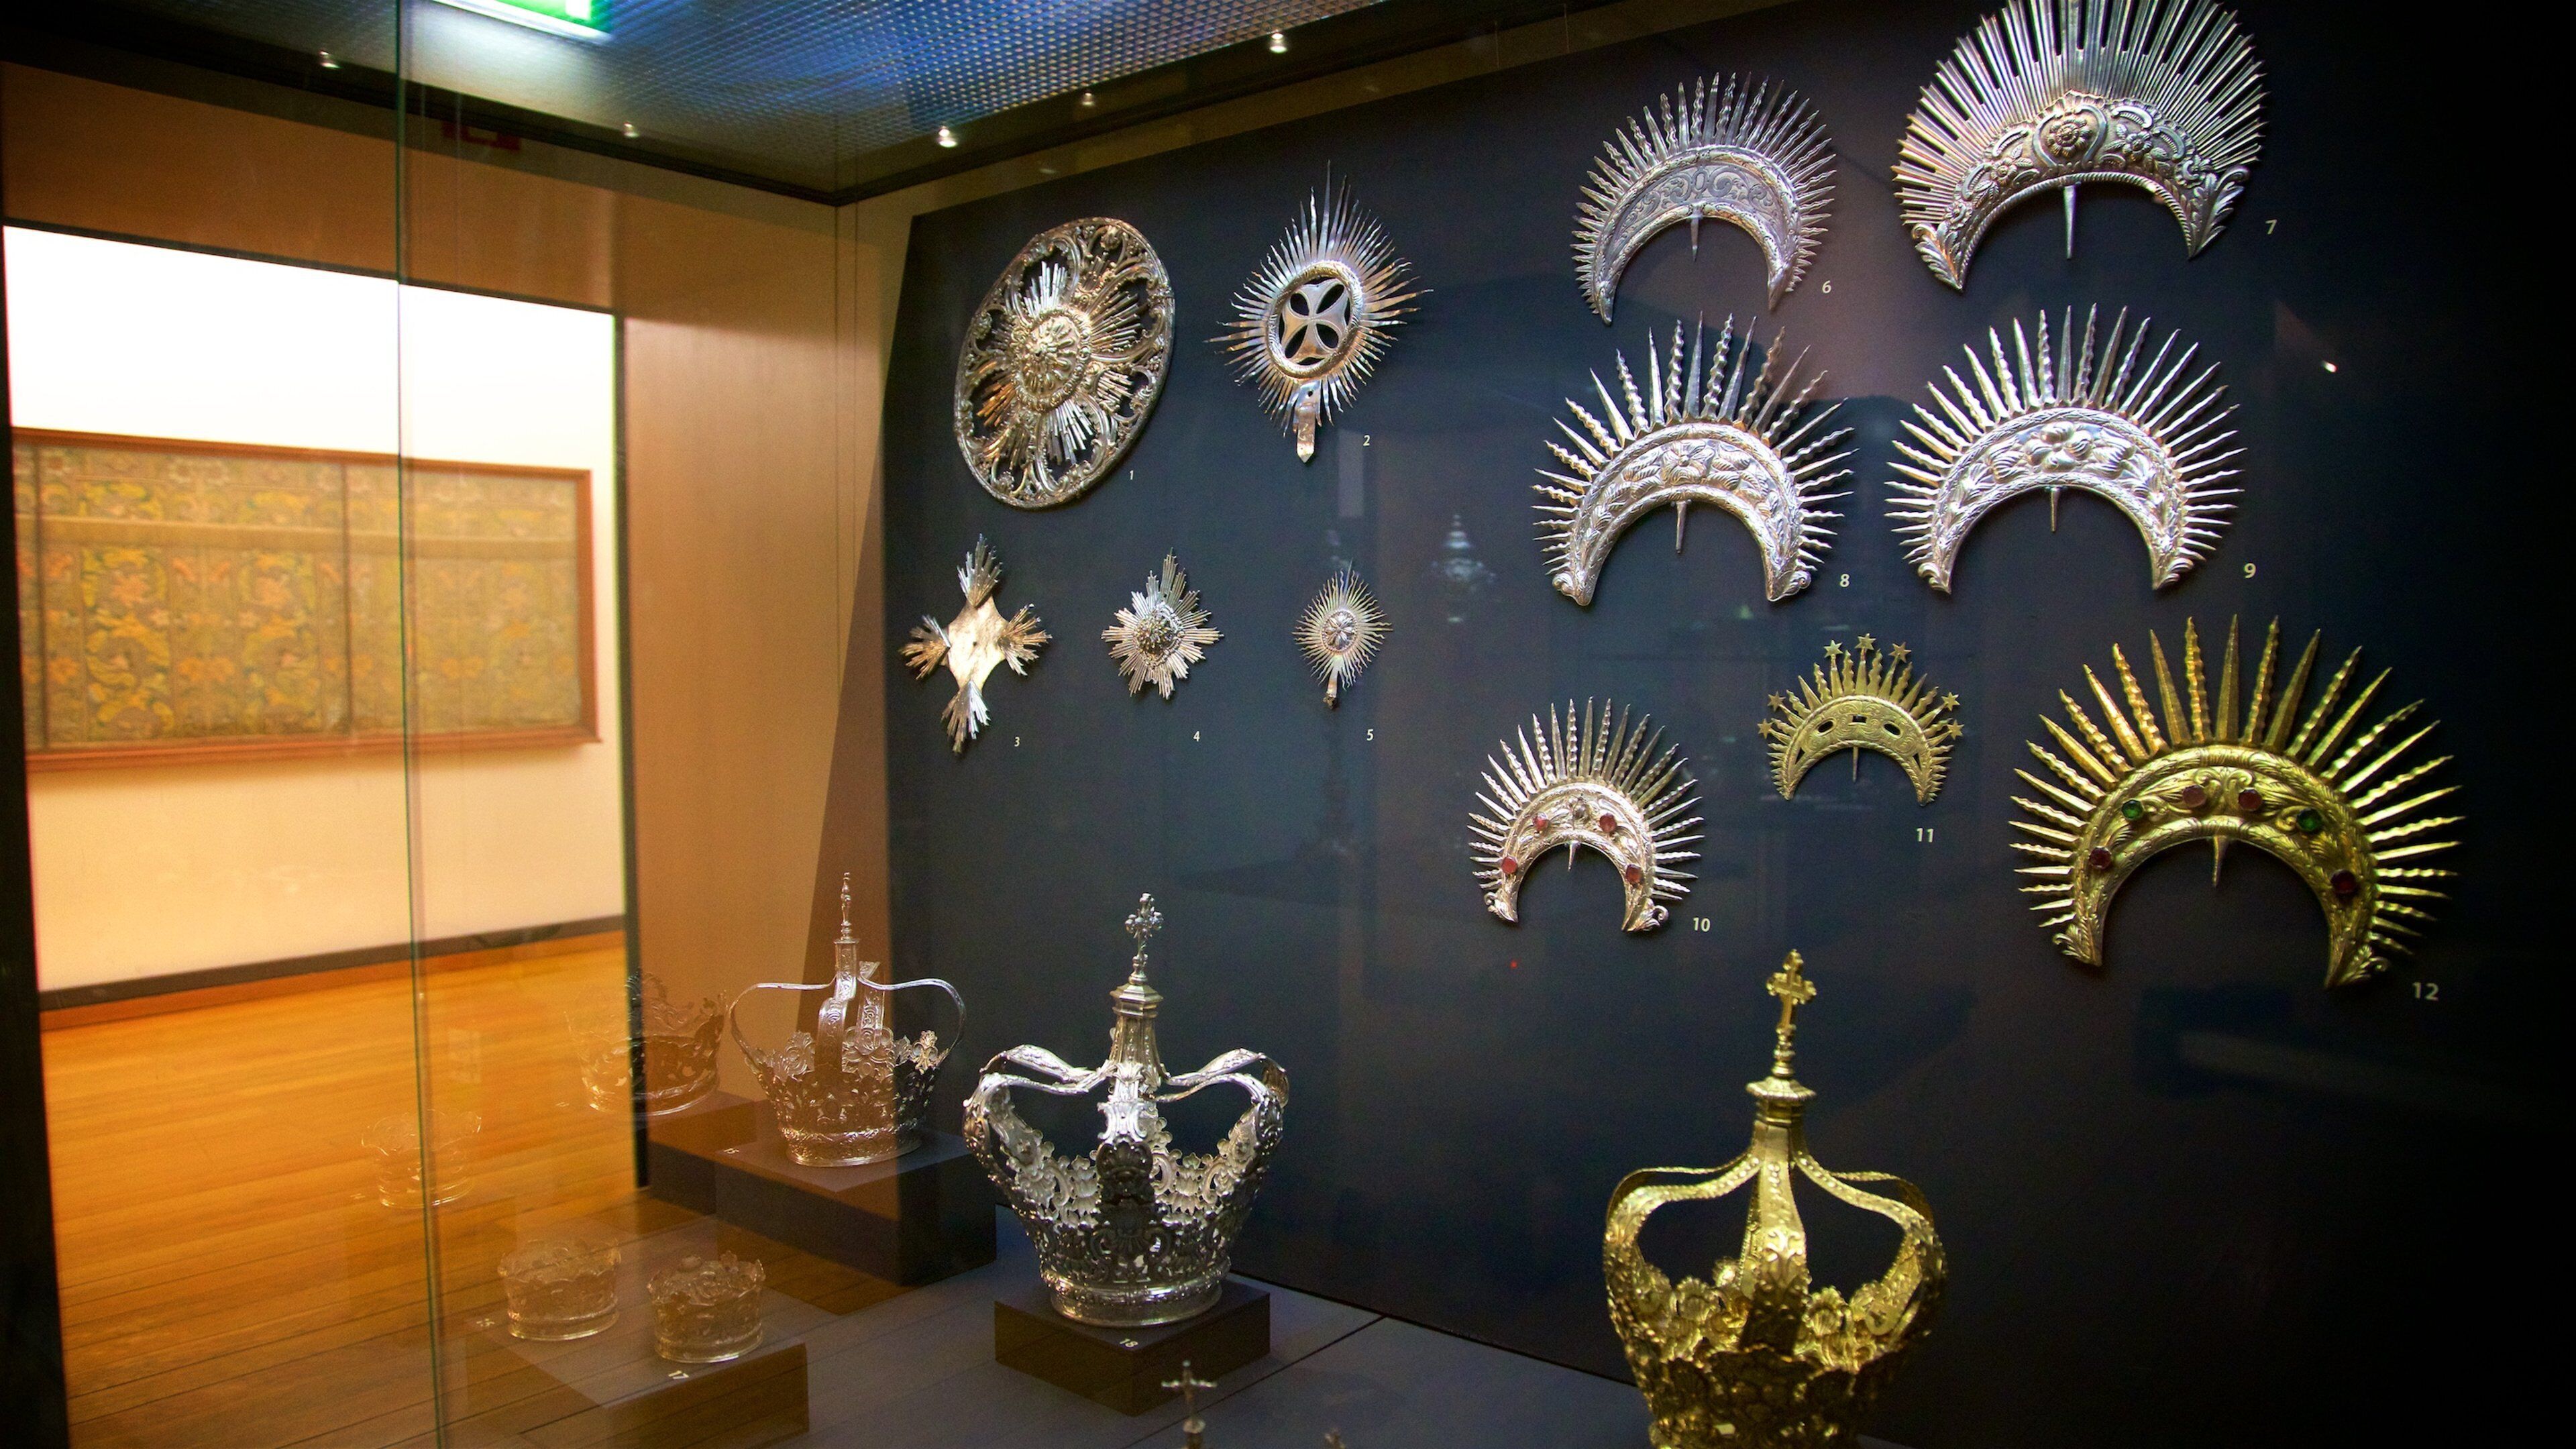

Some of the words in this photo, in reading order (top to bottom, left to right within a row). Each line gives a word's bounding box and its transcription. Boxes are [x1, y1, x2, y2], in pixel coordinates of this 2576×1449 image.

[2265, 219, 2277, 235] 7
[1821, 280, 1832, 294] 6
[1362, 435, 1371, 446] 2
[1129, 470, 1134, 480] 1
[2243, 562, 2256, 579] 9
[1839, 573, 1850, 588] 8
[1014, 736, 1020, 747] 3
[1193, 731, 1200, 742] 4
[1366, 729, 1374, 741] 5
[1916, 827, 1934, 843] 11
[1693, 917, 1711, 932] 10
[2412, 981, 2439, 1001] 12
[1119, 1338, 1138, 1348] 18
[668, 1370, 690, 1380] 17
